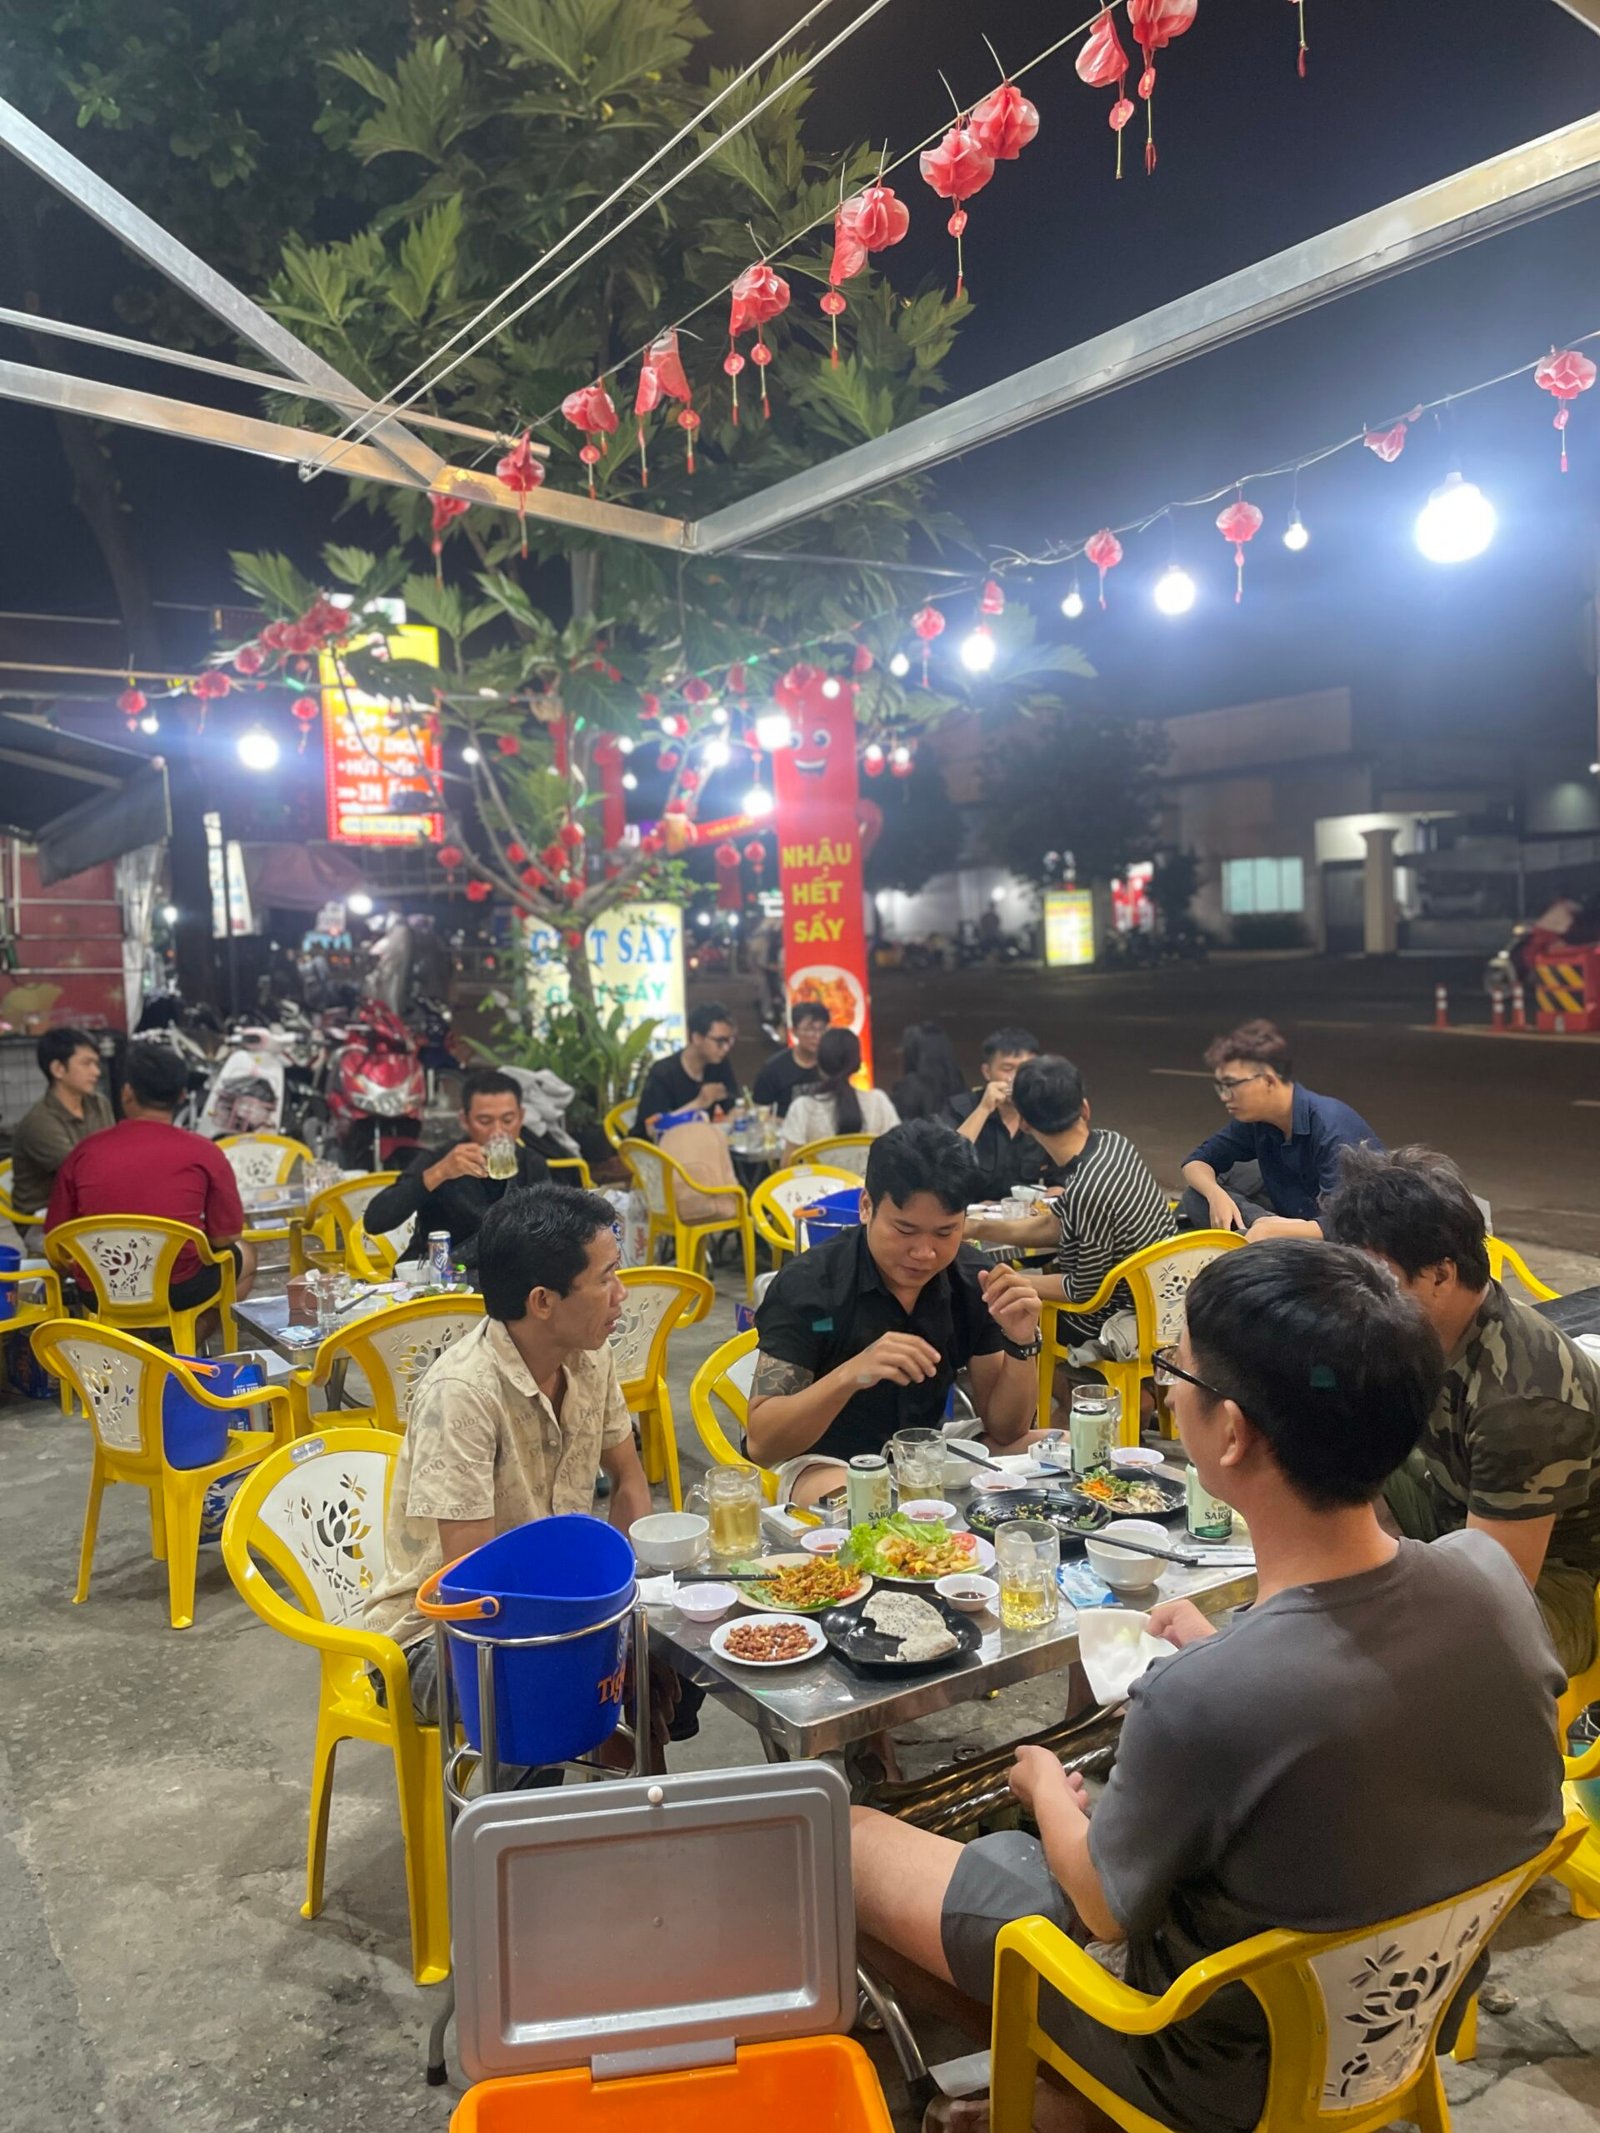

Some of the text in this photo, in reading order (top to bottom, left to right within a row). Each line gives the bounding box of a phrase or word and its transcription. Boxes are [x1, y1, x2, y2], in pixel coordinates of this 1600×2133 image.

[782, 837, 852, 871] NHẬU
[791, 872, 843, 905] HẾT
[793, 910, 845, 943] SẤY
[452, 1416, 480, 1430] Dior
[1204, 1510, 1233, 1521] SAIGO
